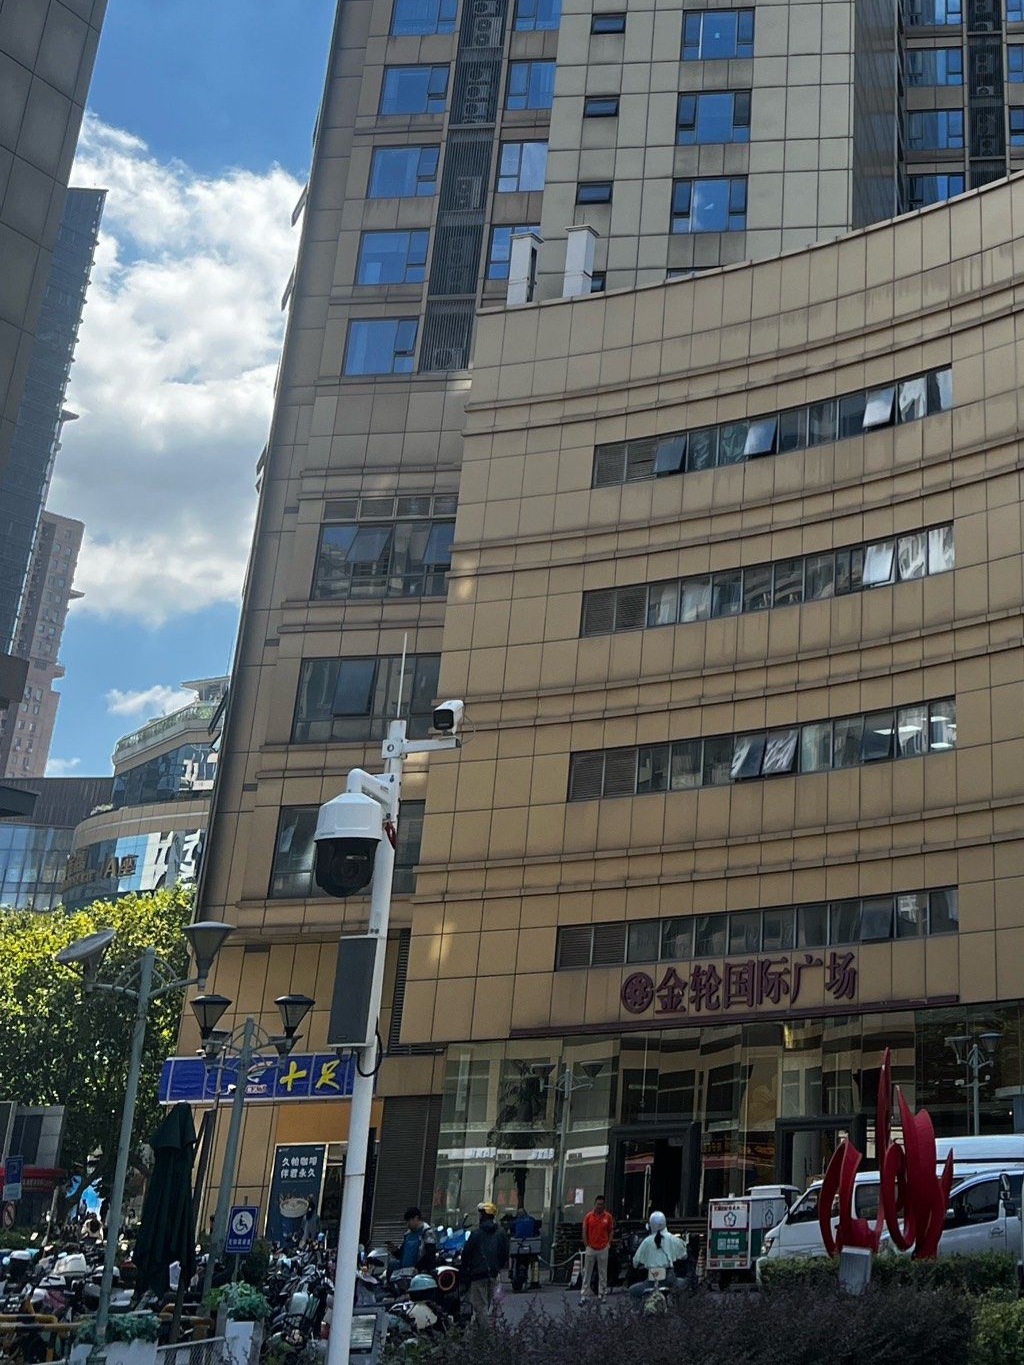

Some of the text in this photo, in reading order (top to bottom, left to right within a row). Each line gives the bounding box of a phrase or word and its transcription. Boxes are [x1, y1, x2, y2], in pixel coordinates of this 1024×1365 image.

[655, 953, 857, 1014] 金轮国际广场
[279, 1059, 341, 1091] 十足
